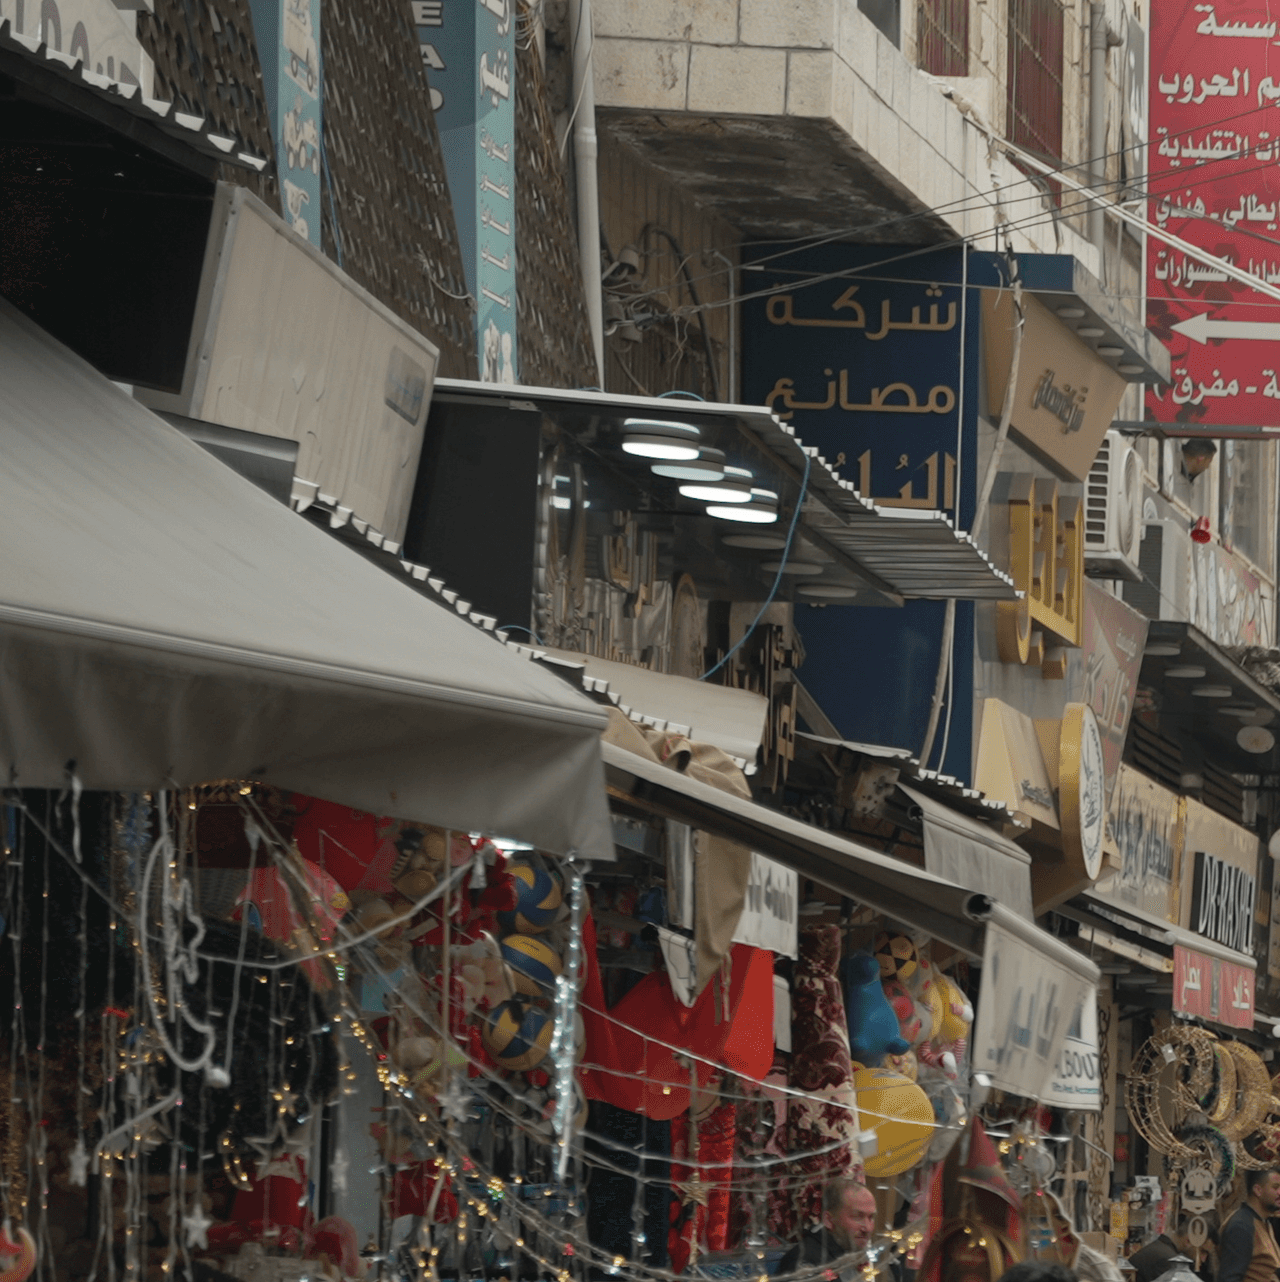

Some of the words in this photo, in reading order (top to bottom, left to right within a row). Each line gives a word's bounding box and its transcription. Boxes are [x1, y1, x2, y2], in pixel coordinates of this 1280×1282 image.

[1158, 66, 1249, 105] الحروب
[1156, 126, 1249, 168] التقليدية
[766, 281, 958, 341] شركة
[764, 367, 957, 421] مصانع
